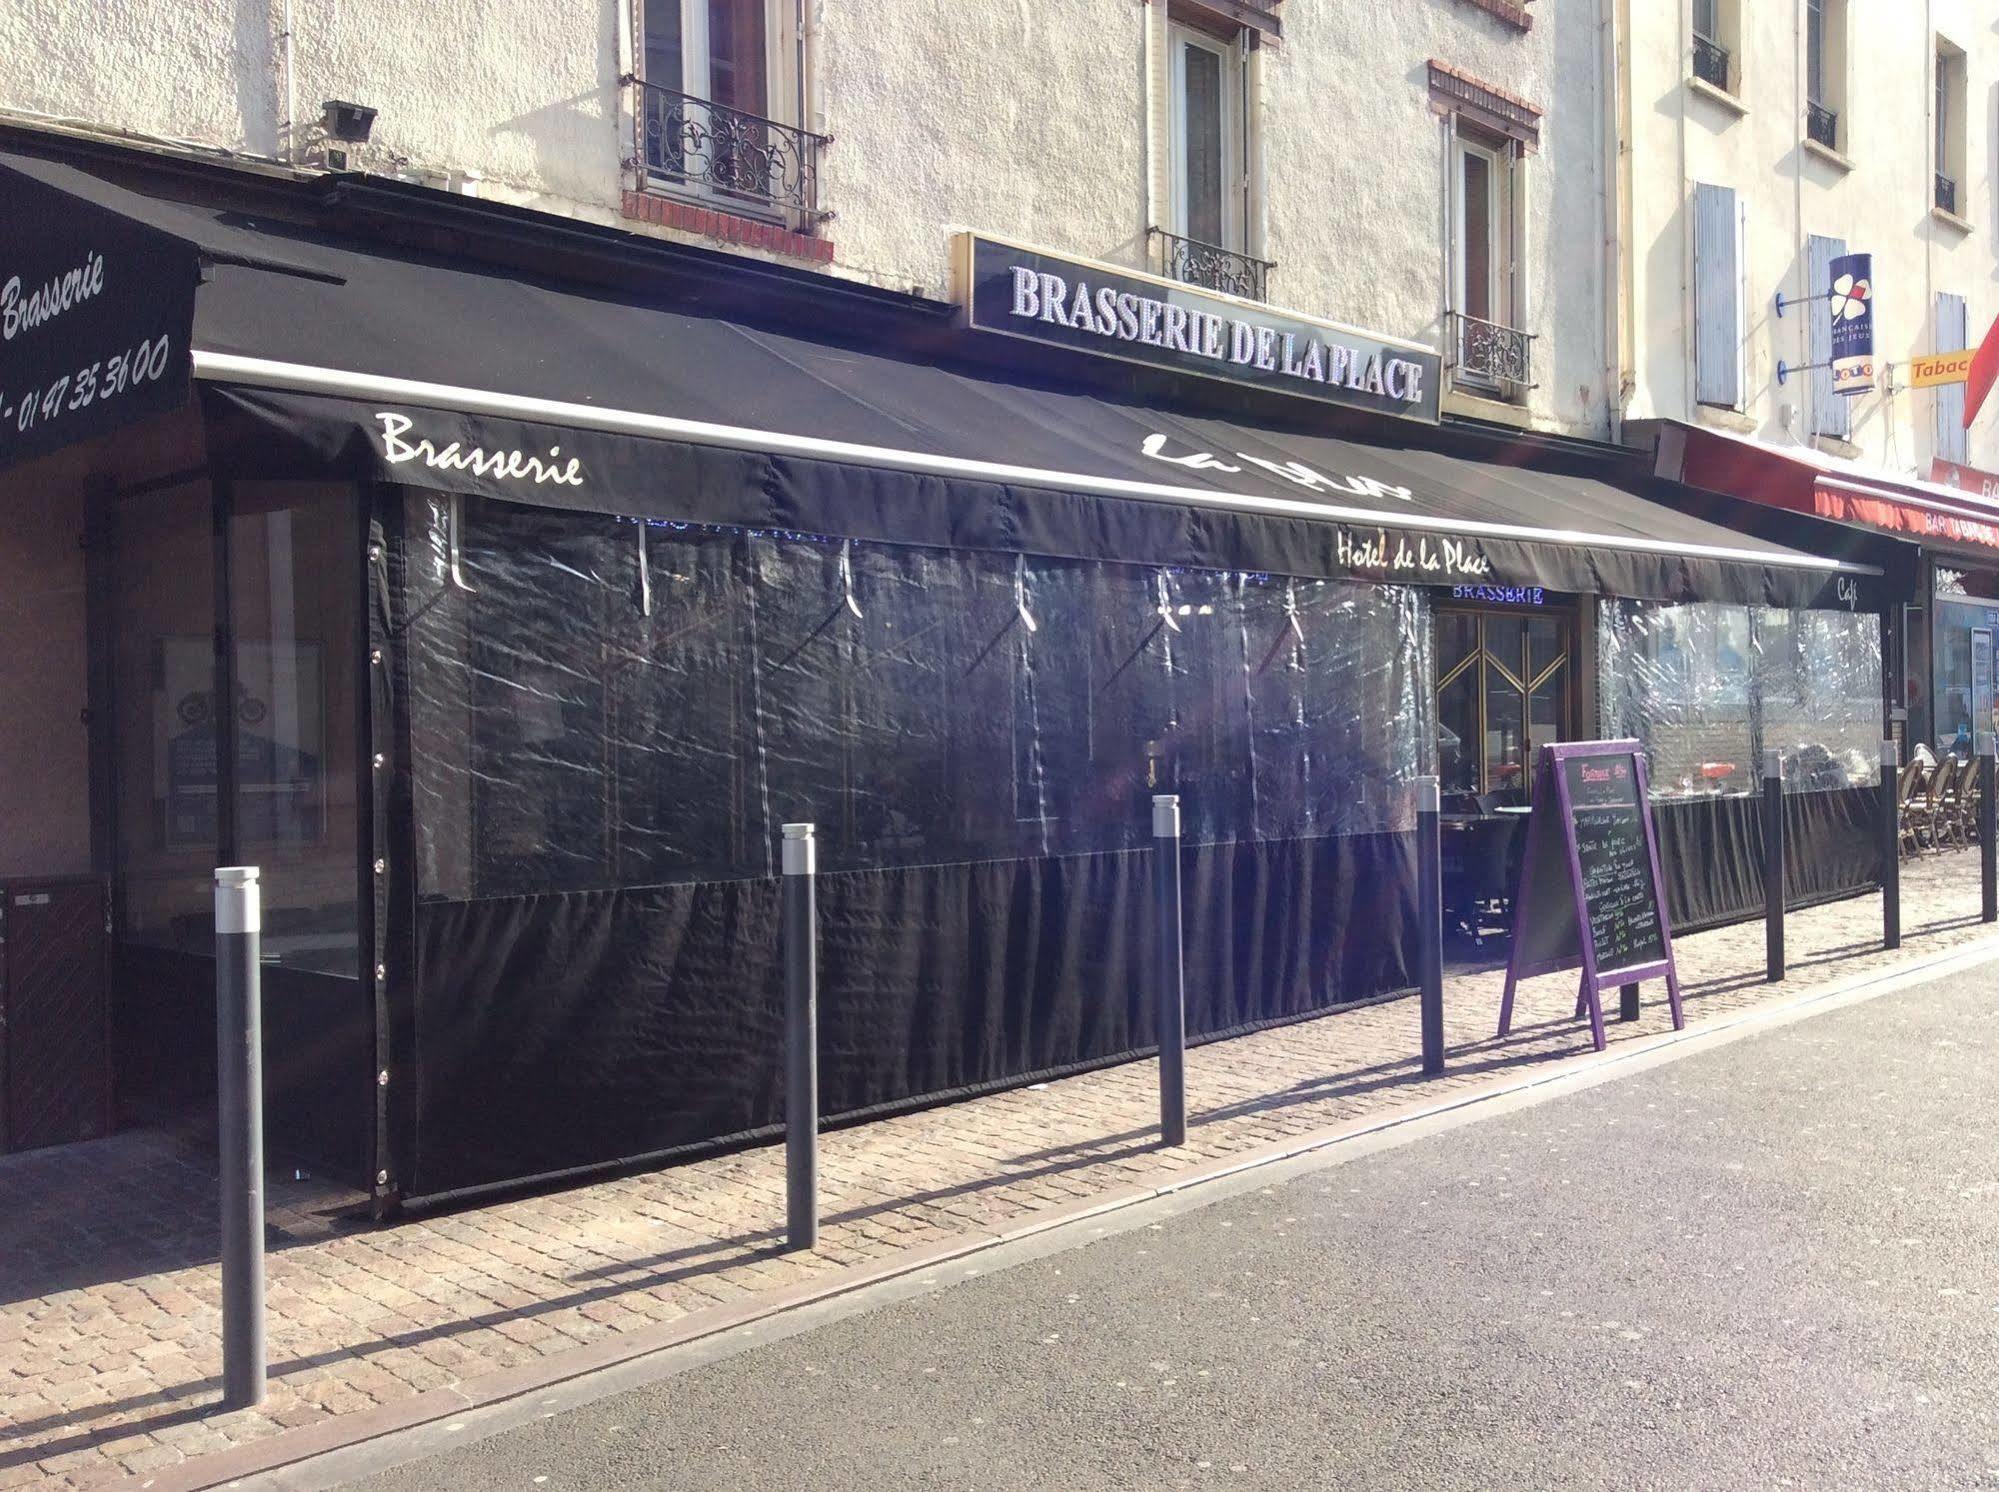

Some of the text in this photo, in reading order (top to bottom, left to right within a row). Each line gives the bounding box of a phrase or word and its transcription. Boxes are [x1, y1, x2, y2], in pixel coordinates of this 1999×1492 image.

[1, 251, 104, 340] Brasserie
[1009, 266, 1423, 403] BRASSERIE DE LA PLACE
[68, 362, 100, 410] 35
[132, 334, 169, 385] 00
[1833, 364, 1873, 381] LOTO
[1912, 360, 1968, 378] Tabac
[375, 412, 584, 486] Brasserie
[1926, 513, 1946, 533] BAR
[1394, 538, 1415, 569] de
[1420, 538, 1441, 571] la
[1442, 538, 1490, 574] Place
[1453, 585, 1544, 605] BRASSERIE
